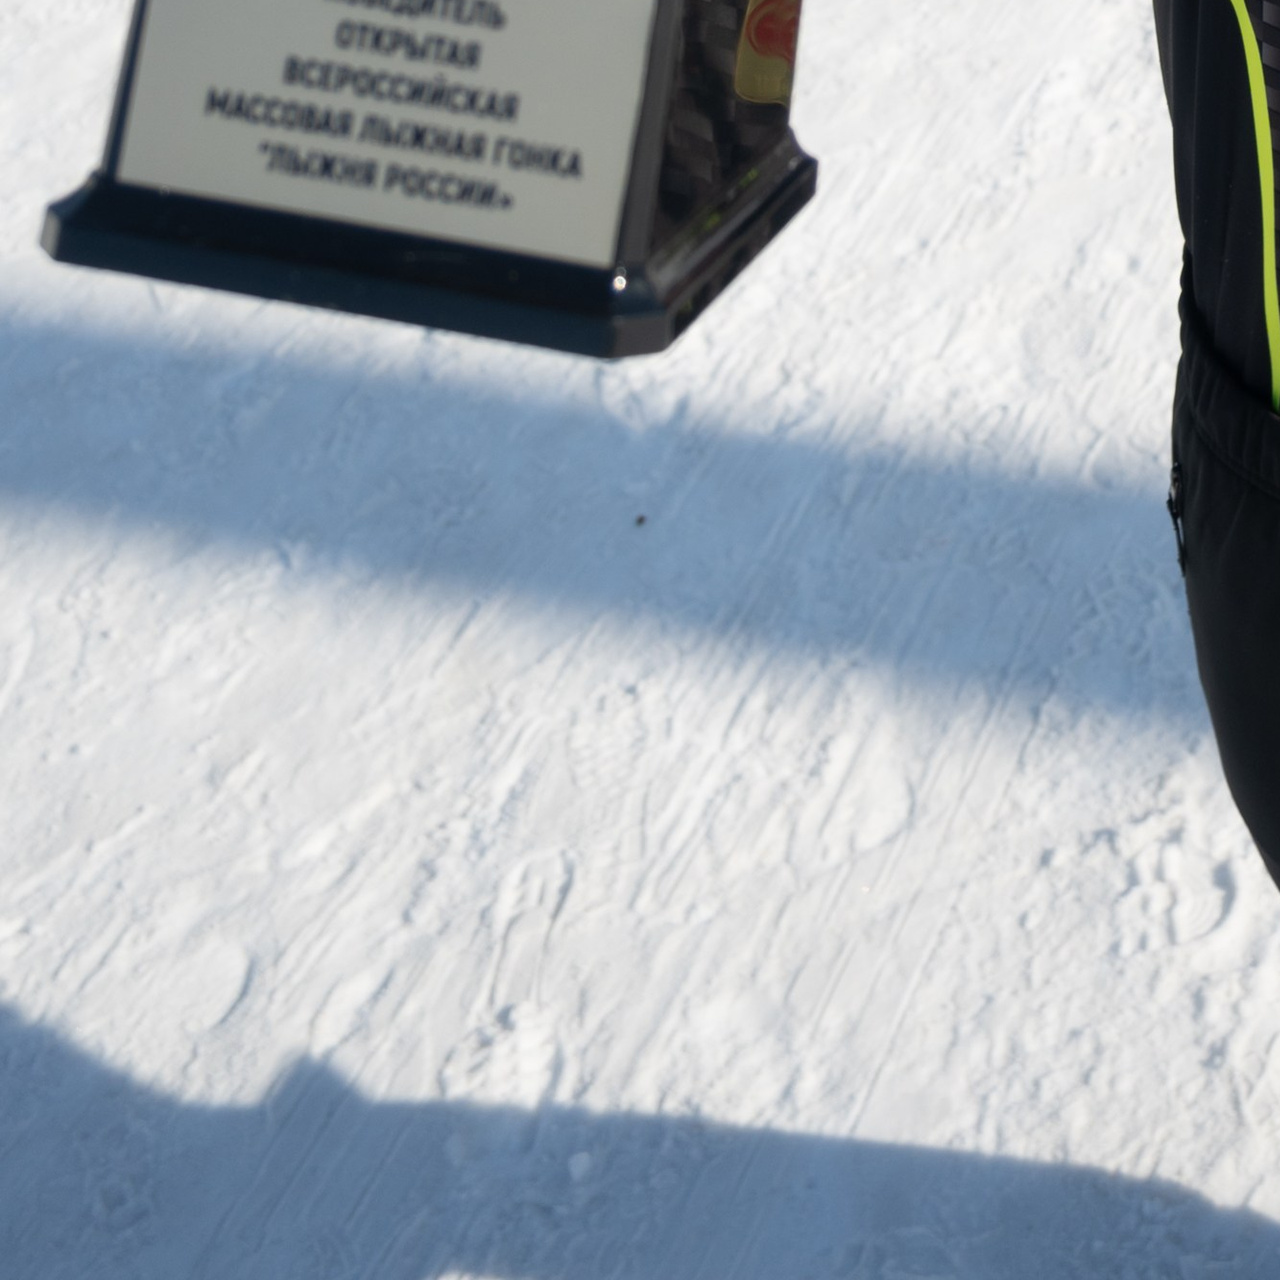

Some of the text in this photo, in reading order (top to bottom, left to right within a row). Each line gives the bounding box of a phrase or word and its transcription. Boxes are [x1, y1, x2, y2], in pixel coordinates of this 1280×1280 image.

[333, 19, 482, 69] ОТКРЫТАЯ
[282, 54, 520, 122] ВСЕРОССИЙСКАЯ
[204, 86, 583, 178] МАССОВАЯ ЛЫЖНАЯ ГОНКА
